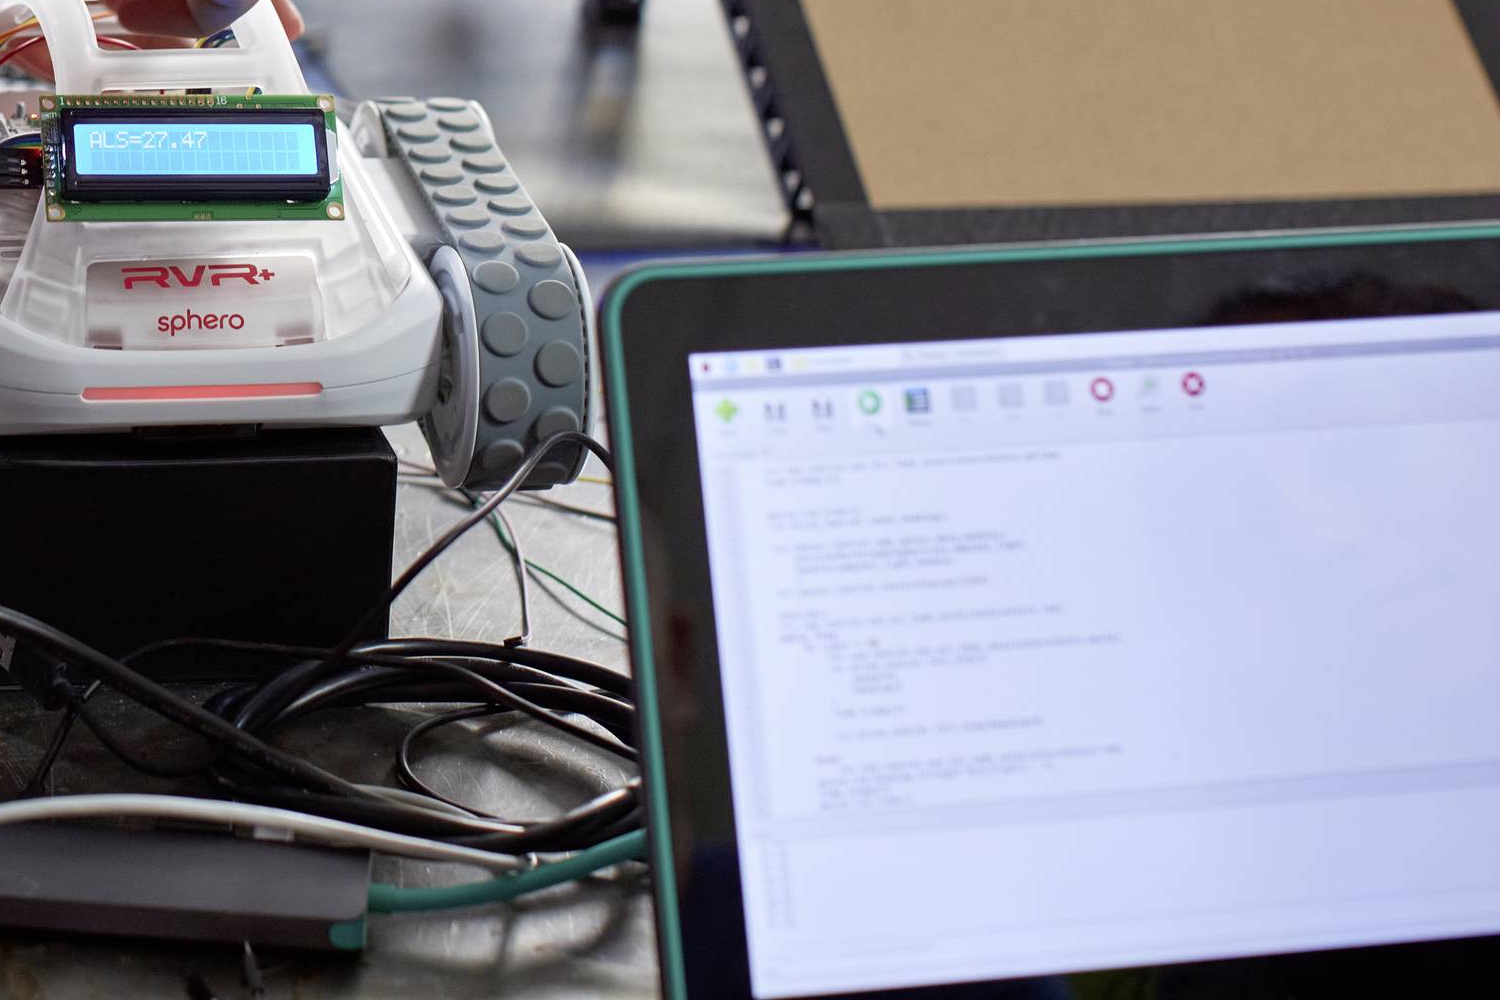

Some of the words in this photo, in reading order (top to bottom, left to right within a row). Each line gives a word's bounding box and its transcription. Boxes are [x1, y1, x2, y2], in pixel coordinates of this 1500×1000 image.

[216, 96, 227, 106] 16
[89, 131, 208, 149] ALS=27.47
[121, 263, 275, 290] RVR+
[157, 309, 245, 337] sphero
